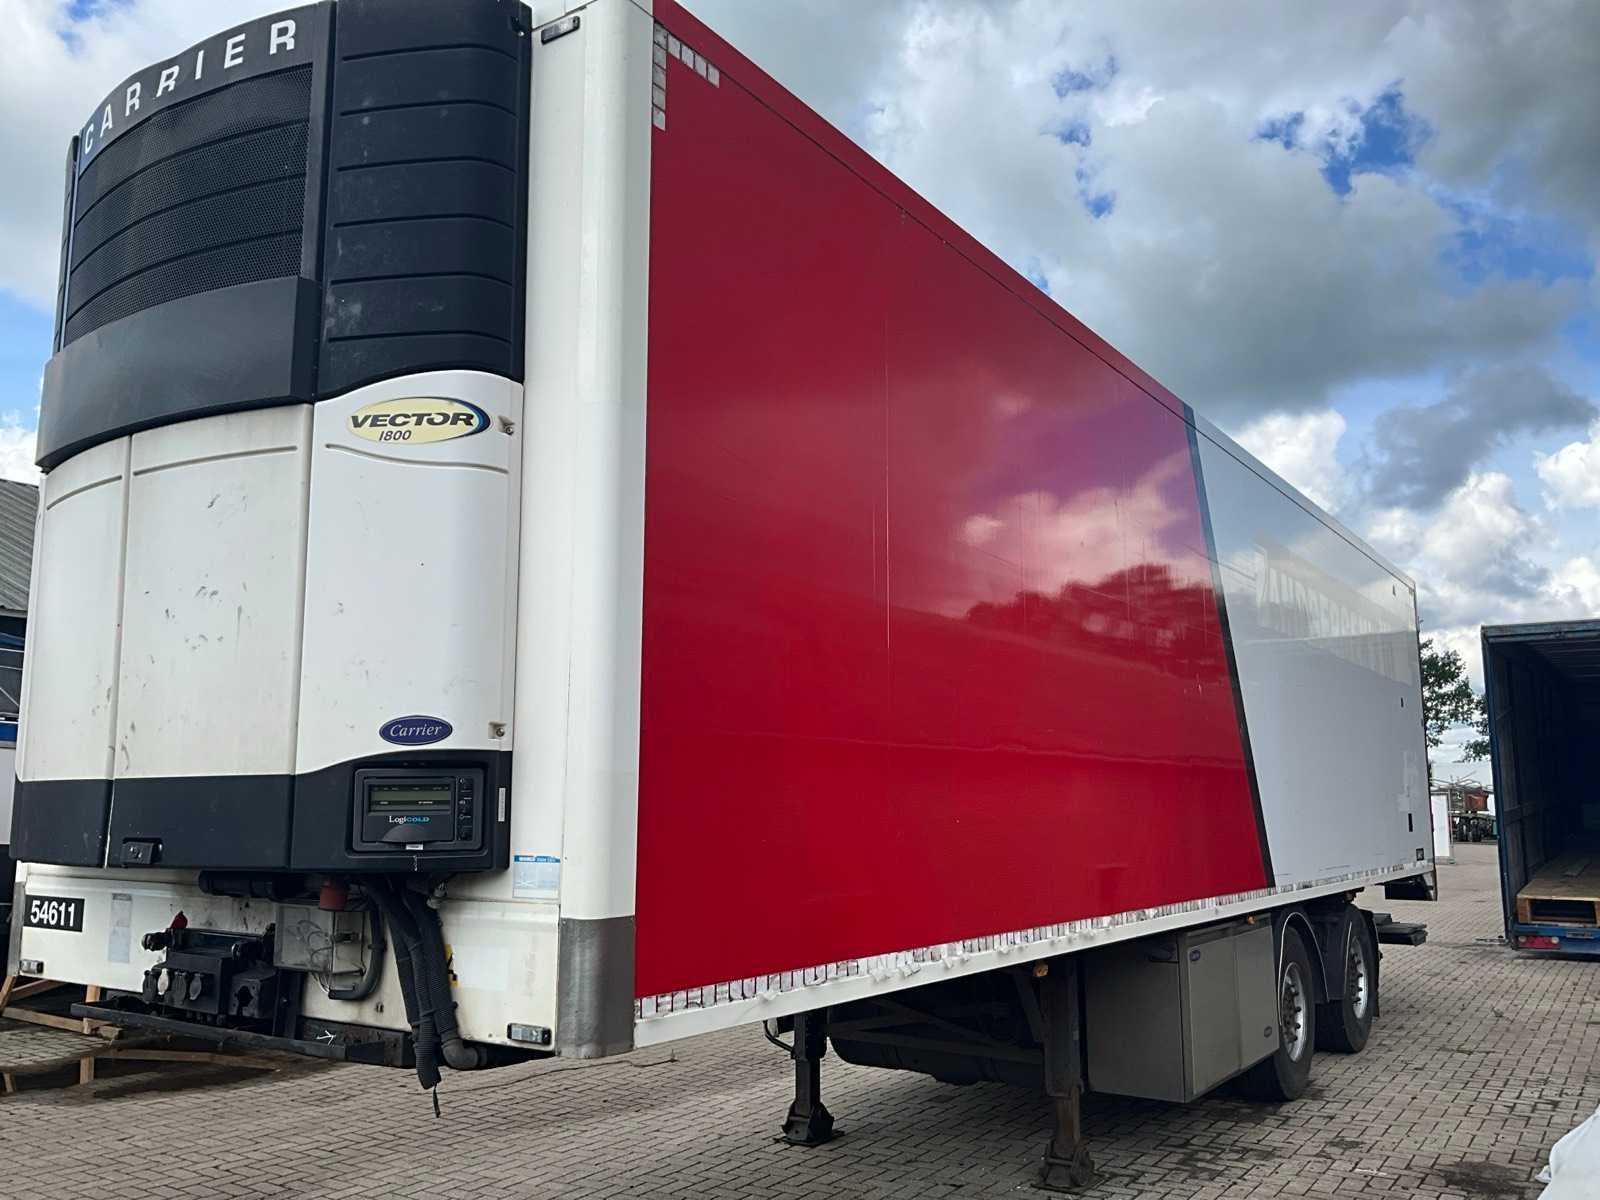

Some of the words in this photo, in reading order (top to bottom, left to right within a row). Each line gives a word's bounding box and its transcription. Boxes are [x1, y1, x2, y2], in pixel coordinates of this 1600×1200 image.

[84, 19, 296, 154] CARRIER
[351, 412, 475, 428] VECTOR
[379, 430, 412, 441] 1800
[390, 724, 442, 737] Carrier
[30, 899, 76, 927] 54611
